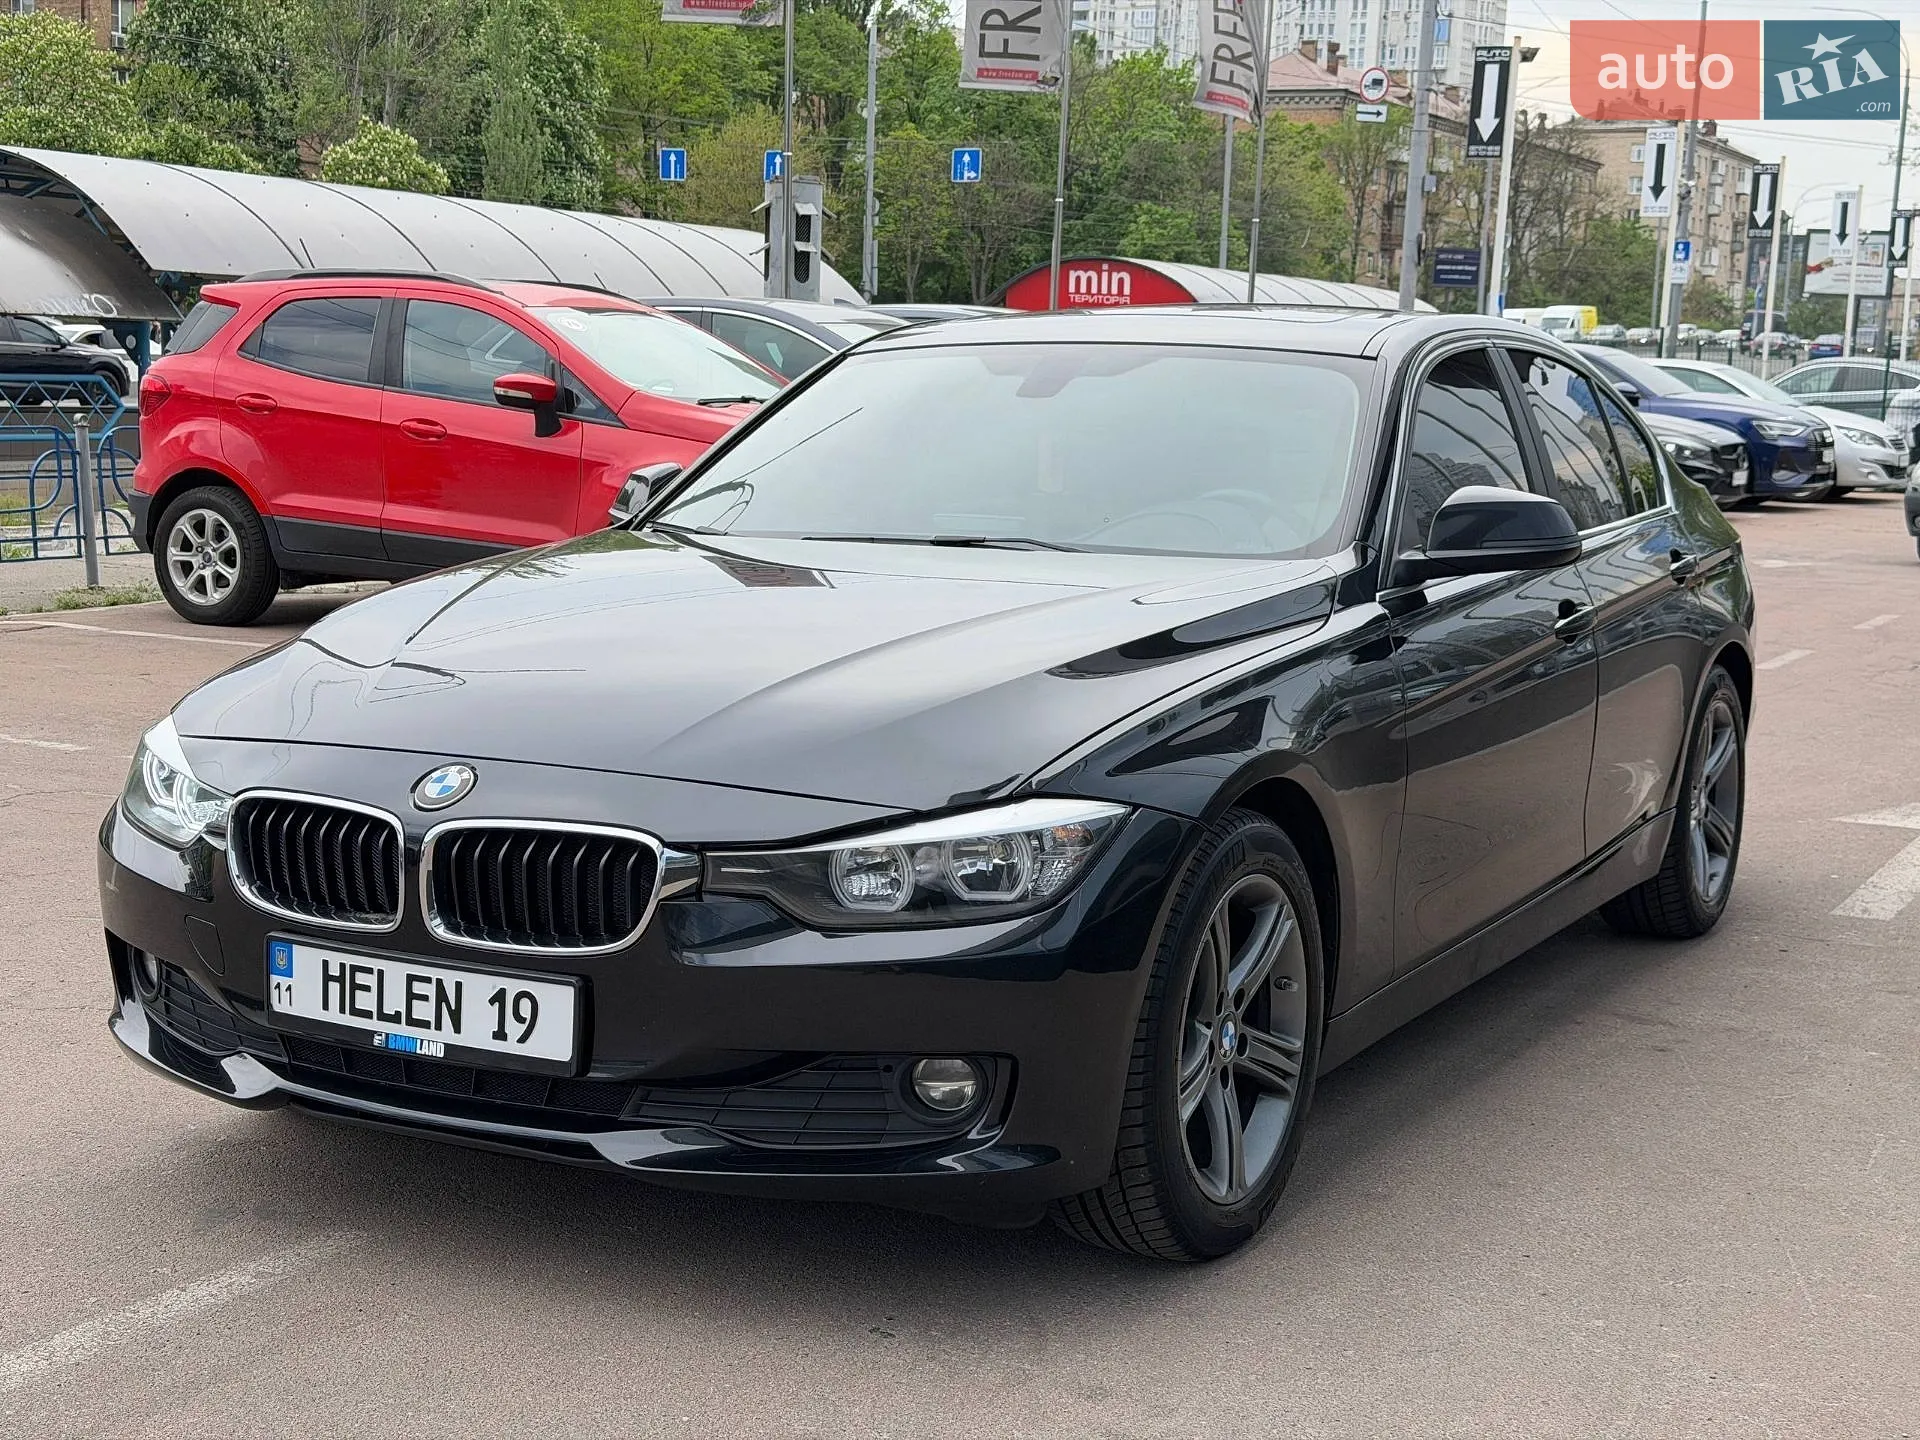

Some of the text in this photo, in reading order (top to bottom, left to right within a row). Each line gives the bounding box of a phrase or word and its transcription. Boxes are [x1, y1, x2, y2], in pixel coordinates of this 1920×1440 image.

[978, 0, 1042, 61] FR
[1068, 263, 1131, 296] min
[272, 980, 294, 1008] 11
[320, 958, 540, 1045] HELEN 19
[388, 1032, 445, 1058] BMWLAND
